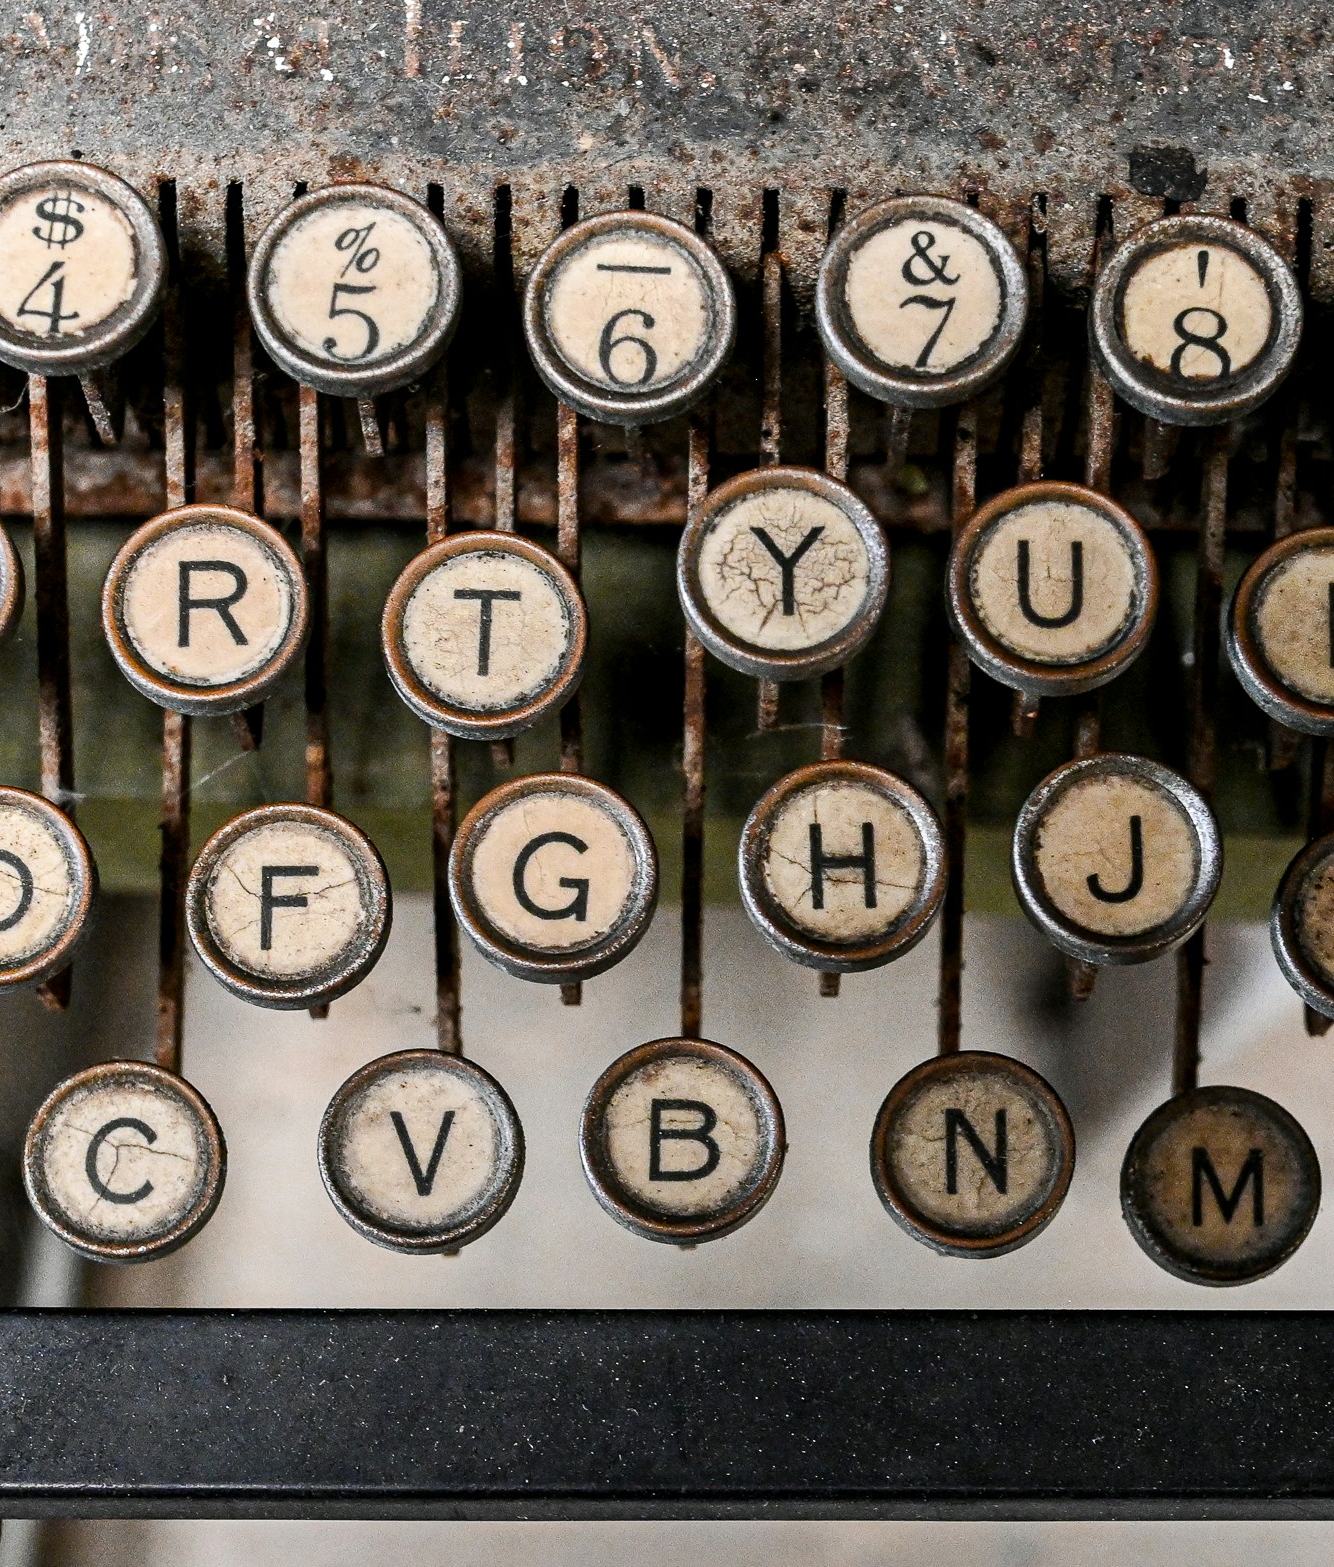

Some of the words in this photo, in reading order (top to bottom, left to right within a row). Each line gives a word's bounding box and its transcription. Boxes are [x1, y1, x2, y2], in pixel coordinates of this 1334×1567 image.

[31, 189, 86, 251] $
[334, 221, 381, 277] %
[902, 230, 961, 287] &
[16, 261, 81, 336] 4
[321, 283, 381, 360] 5
[898, 295, 957, 370] 7
[598, 309, 659, 389] 6
[1170, 306, 1233, 380] 8
[177, 559, 249, 649] R
[749, 526, 826, 618] Y
[1014, 539, 1085, 630] U
[453, 587, 523, 677] T
[512, 831, 590, 922] G
[807, 819, 879, 911] H
[1085, 814, 1145, 905] J
[260, 864, 320, 952] F
[84, 1117, 158, 1205] C
[389, 1110, 457, 1197] V
[646, 1097, 722, 1183] B
[943, 1106, 1009, 1196] N
[1190, 1145, 1267, 1228] M
